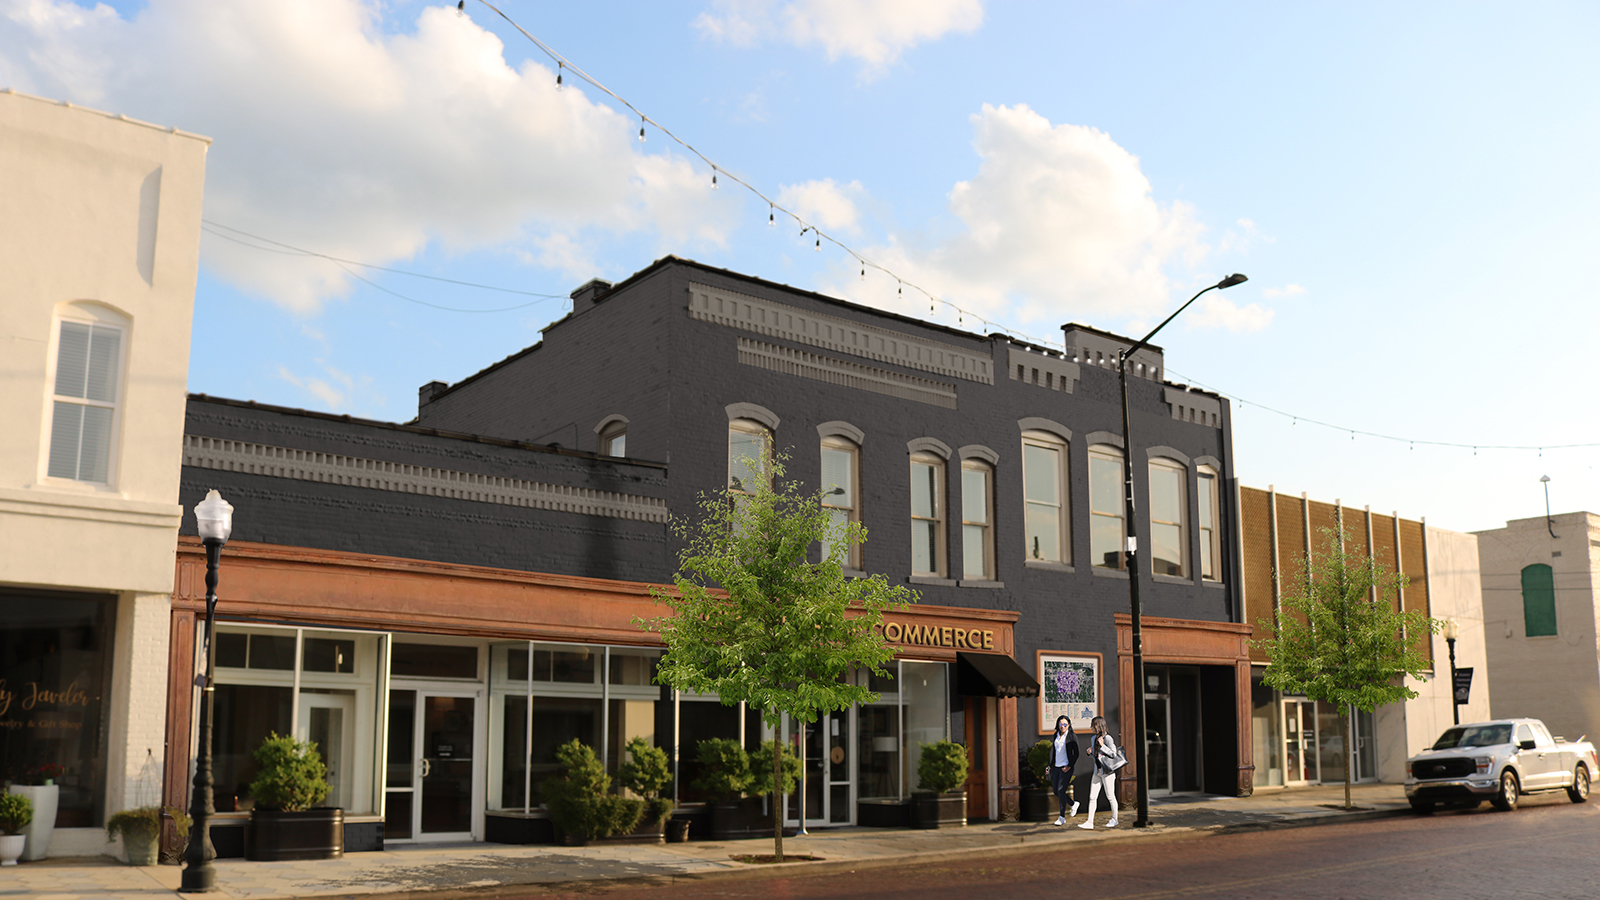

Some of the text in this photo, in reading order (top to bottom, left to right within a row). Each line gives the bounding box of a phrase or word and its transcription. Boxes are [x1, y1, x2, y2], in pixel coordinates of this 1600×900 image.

[22, 681, 91, 711] Jeweler
[27, 719, 36, 728] &
[38, 719, 56, 729] Gift
[58, 719, 83, 731] Shop
